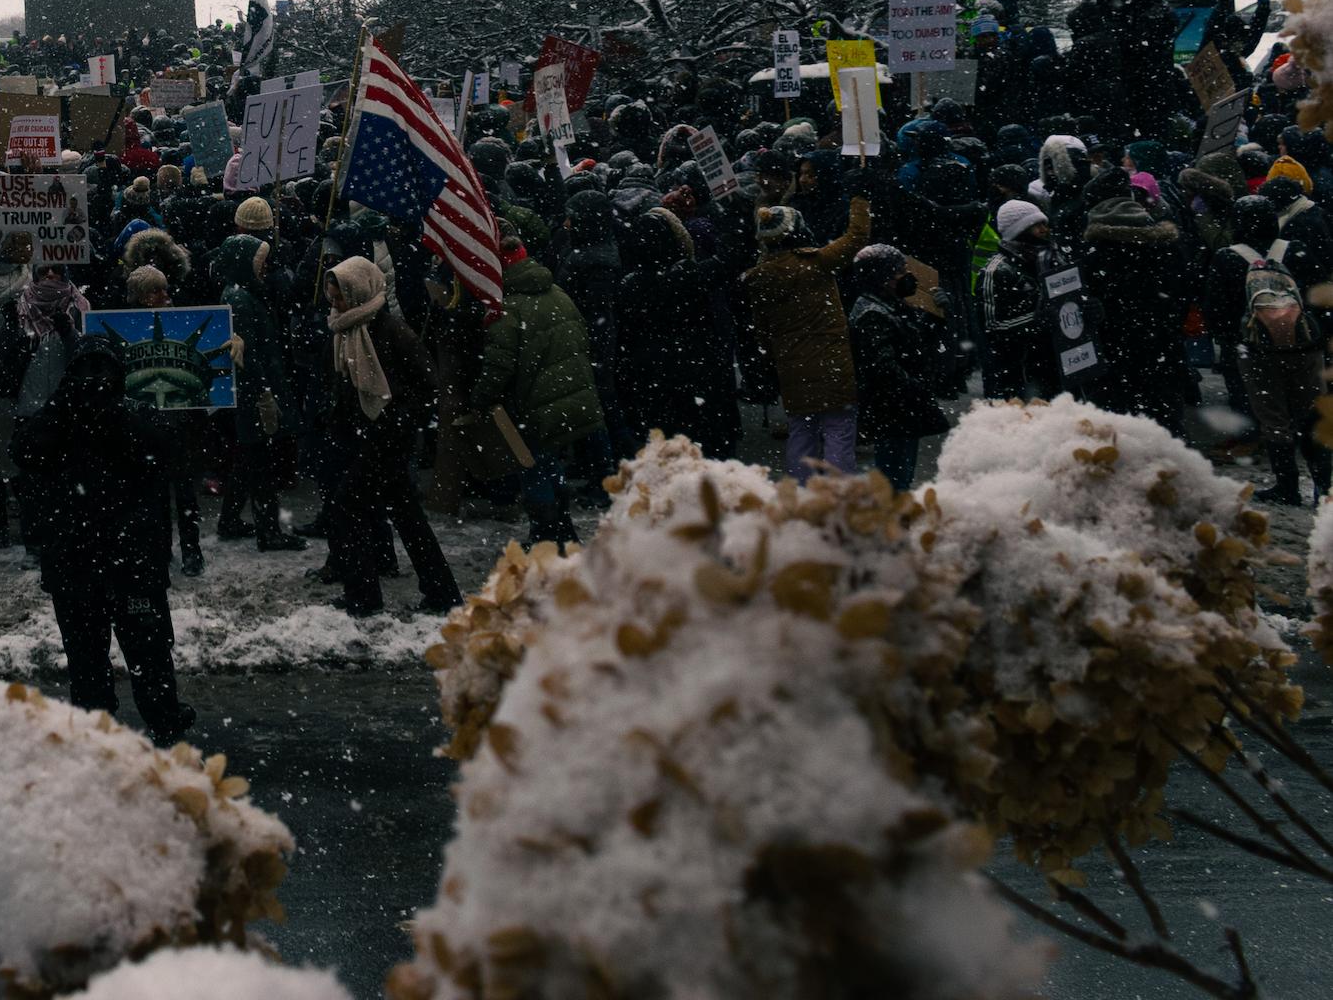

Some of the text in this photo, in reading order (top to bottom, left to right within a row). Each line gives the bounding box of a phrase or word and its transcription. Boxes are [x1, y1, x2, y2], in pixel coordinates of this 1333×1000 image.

[914, 6, 934, 16] THE
[779, 34, 789, 43] EL
[892, 27, 955, 40] TOO DUMB TO
[774, 44, 798, 53] UEBLO
[902, 51, 916, 61] BE
[920, 50, 926, 59] A
[775, 81, 799, 92] UERA
[24, 137, 37, 147] OUT
[2, 212, 52, 225] TRUMP
[38, 226, 65, 239] OUT
[42, 245, 86, 260] NOW!
[174, 345, 194, 361] ICE
